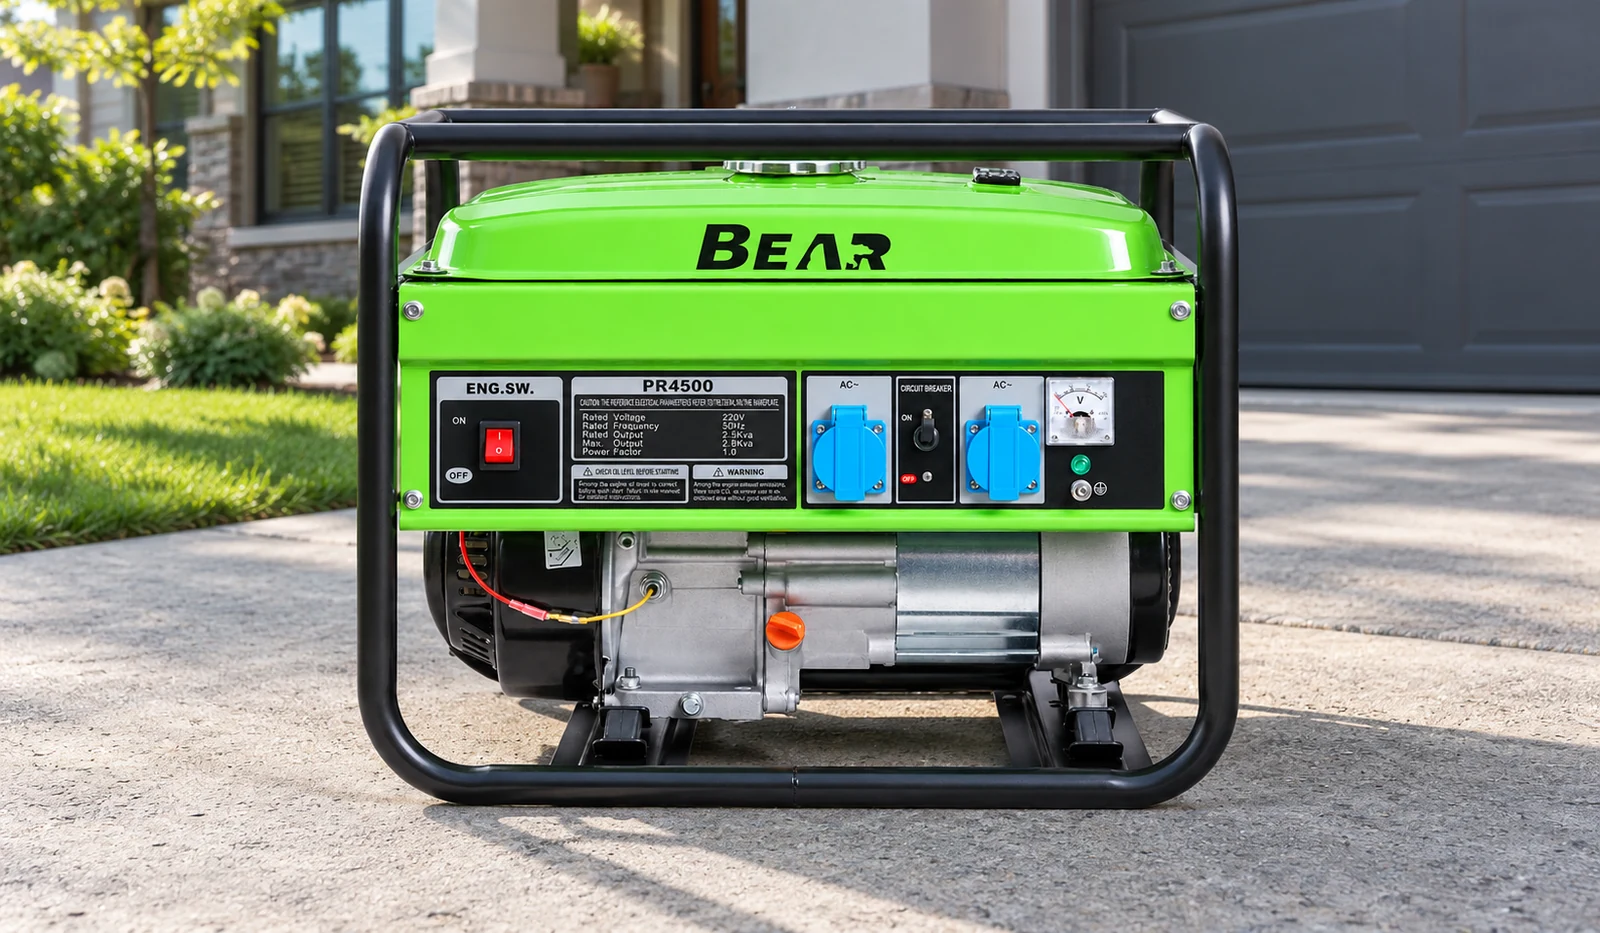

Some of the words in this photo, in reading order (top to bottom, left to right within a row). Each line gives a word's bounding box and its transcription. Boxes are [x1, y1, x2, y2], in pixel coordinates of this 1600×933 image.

[466, 382, 535, 395] ENG.SW.
[643, 379, 713, 393] PR4500
[900, 384, 924, 392] CIRCUIT
[924, 384, 952, 393] BREAKER
[1076, 396, 1084, 404] V
[452, 416, 466, 425] ON
[582, 412, 608, 421] Rated
[613, 412, 646, 423] Voltage
[722, 413, 745, 421] 220V
[582, 421, 608, 430] Rated
[613, 421, 659, 432] Frequency
[582, 430, 608, 439] Rated
[613, 430, 643, 439] Output
[613, 439, 643, 448] Output
[582, 447, 610, 456] Power
[613, 446, 642, 456] Factor
[722, 448, 737, 456] 1.0
[449, 471, 469, 480] OFF
[727, 468, 765, 476] WARNING
